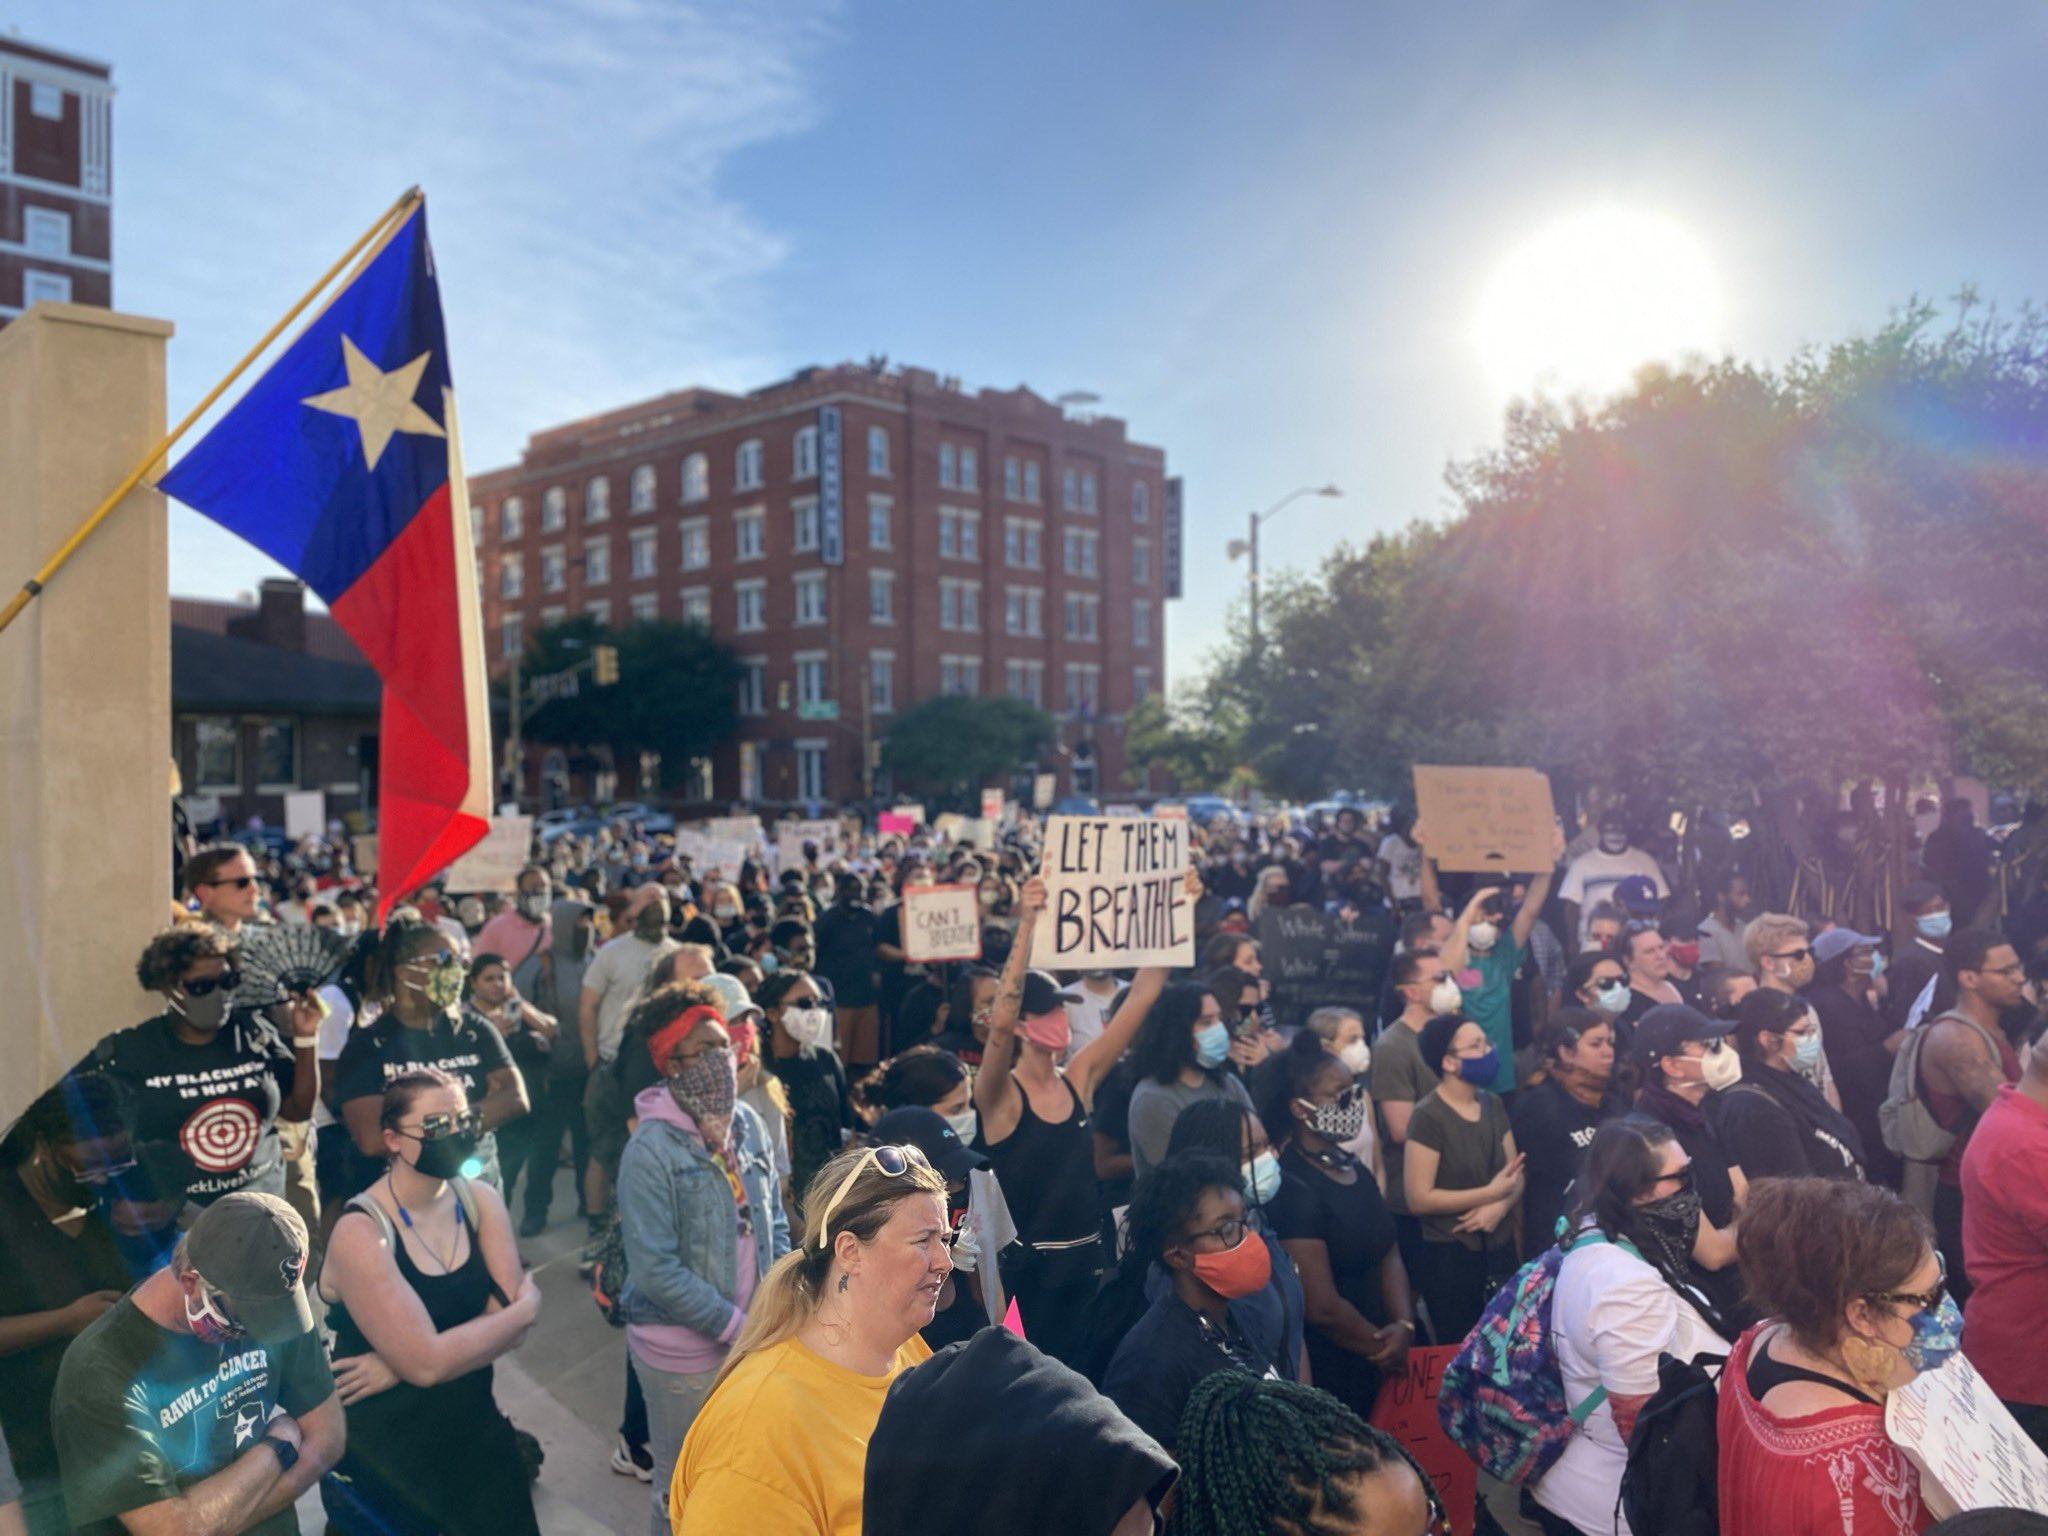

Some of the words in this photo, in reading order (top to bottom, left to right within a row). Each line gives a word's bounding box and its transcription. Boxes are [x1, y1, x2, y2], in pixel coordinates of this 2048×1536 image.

[1061, 823, 1109, 873] LET
[1121, 822, 1178, 873] THEM
[1056, 876, 1189, 953] BREATHE
[201, 1081, 239, 1097] NOT
